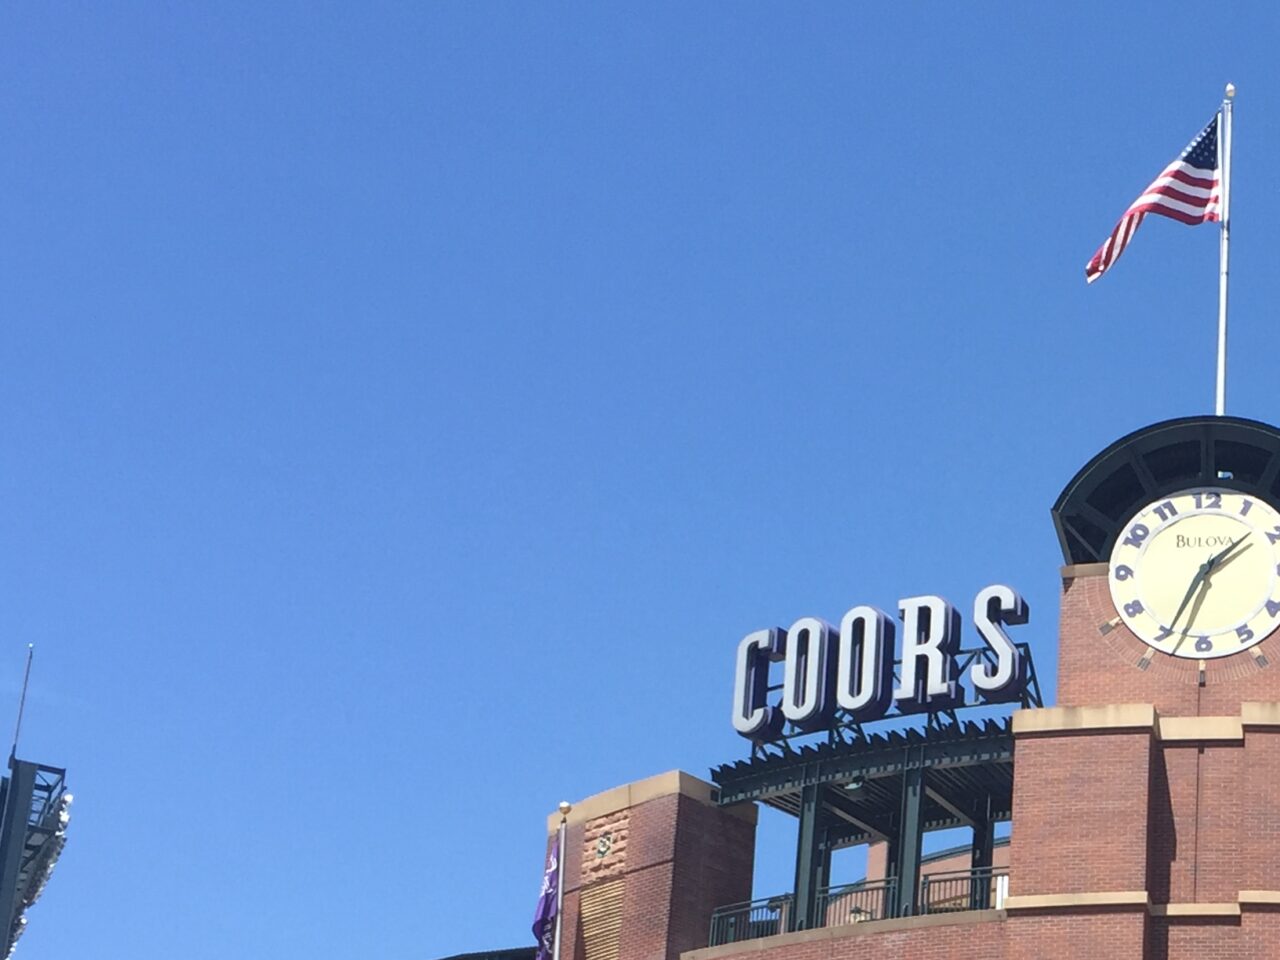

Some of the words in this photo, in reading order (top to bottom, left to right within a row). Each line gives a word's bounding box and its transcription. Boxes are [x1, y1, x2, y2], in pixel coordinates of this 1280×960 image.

[1192, 492, 1221, 509] 12
[1240, 499, 1254, 517] 1
[1152, 500, 1178, 521] 11
[1122, 523, 1150, 549] 10
[1115, 564, 1134, 581] 9
[1123, 599, 1145, 618] 8
[1153, 624, 1175, 643] 7
[1235, 623, 1254, 644] 5
[1194, 635, 1213, 652] 6
[732, 584, 1027, 736] COORS
